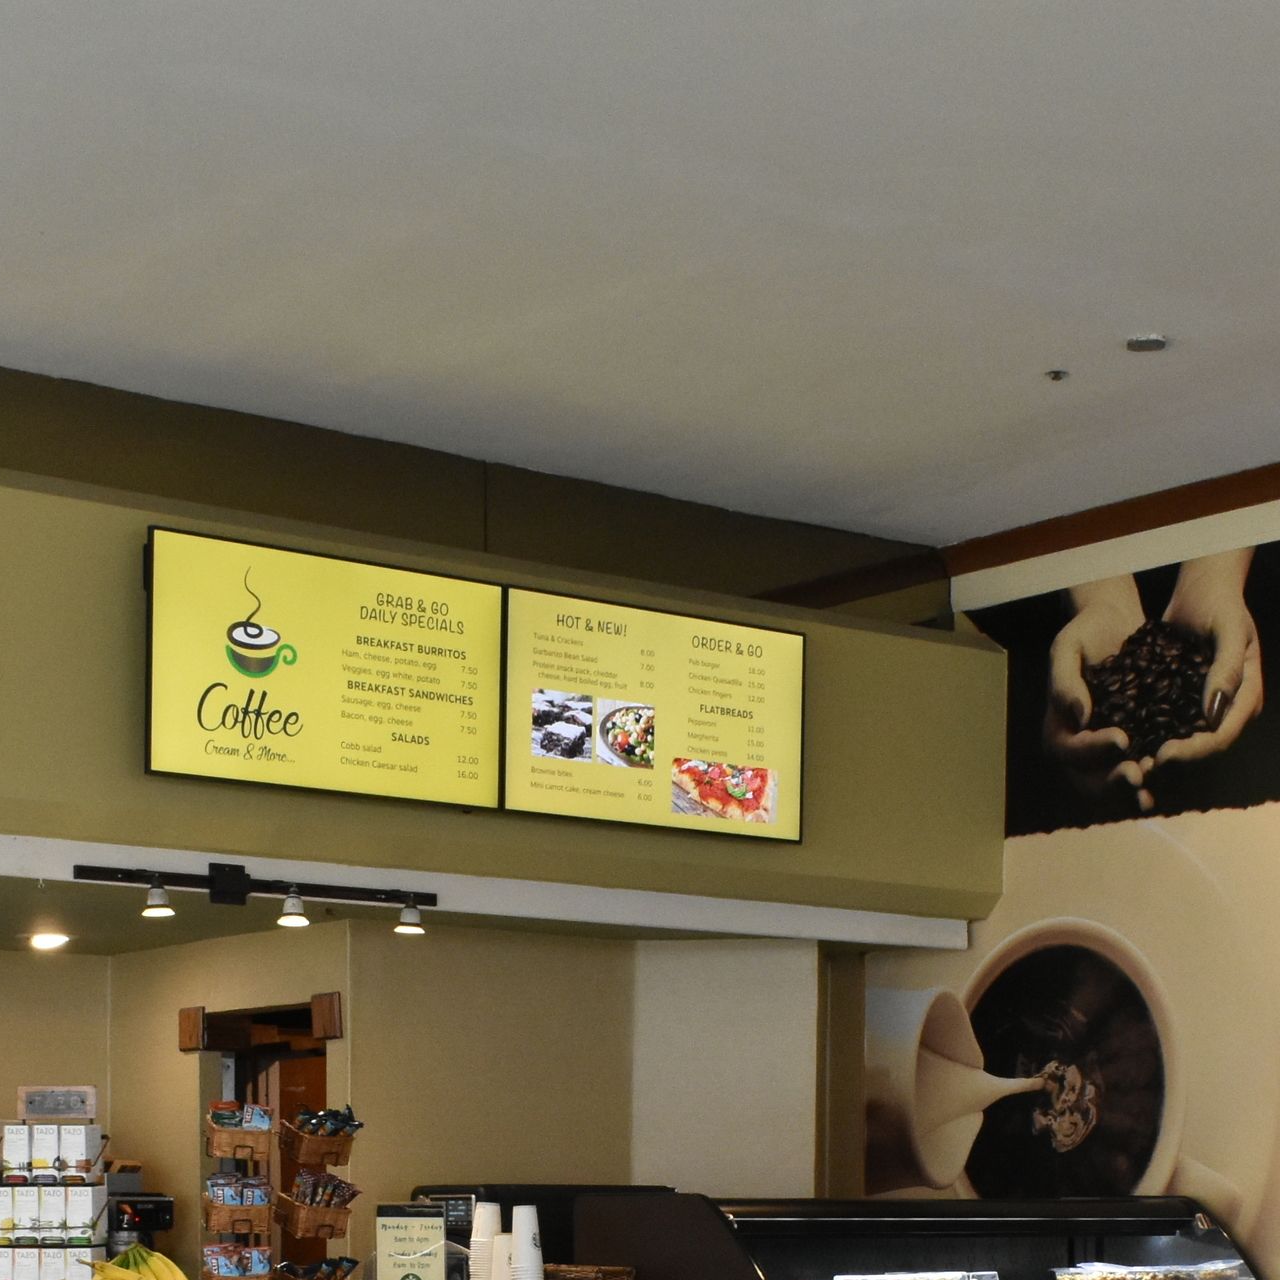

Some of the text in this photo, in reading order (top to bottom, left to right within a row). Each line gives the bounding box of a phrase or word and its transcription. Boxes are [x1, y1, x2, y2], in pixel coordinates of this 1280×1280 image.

[376, 592, 449, 616] GRAB & GO
[360, 605, 464, 635] DAILY SPECIALS
[556, 614, 628, 637] HOT & NEW!
[356, 635, 466, 660] BREAKFAST BURRITOS
[692, 635, 763, 659] ORDER & GO
[461, 666, 478, 676] 7.50
[347, 680, 473, 706] BREAKFAST SANDWICHES
[461, 681, 477, 690] 7.50
[197, 682, 303, 740] Coffee
[460, 711, 477, 720] 7.50
[700, 704, 753, 720] FLATBREADS
[391, 732, 430, 746] SALADS
[460, 725, 477, 735] 7.50
[204, 739, 240, 757] Cream
[243, 742, 255, 760] &
[341, 741, 479, 765] Cobb salad 12.00
[340, 757, 478, 780] Chicken Caesar salad 16.00
